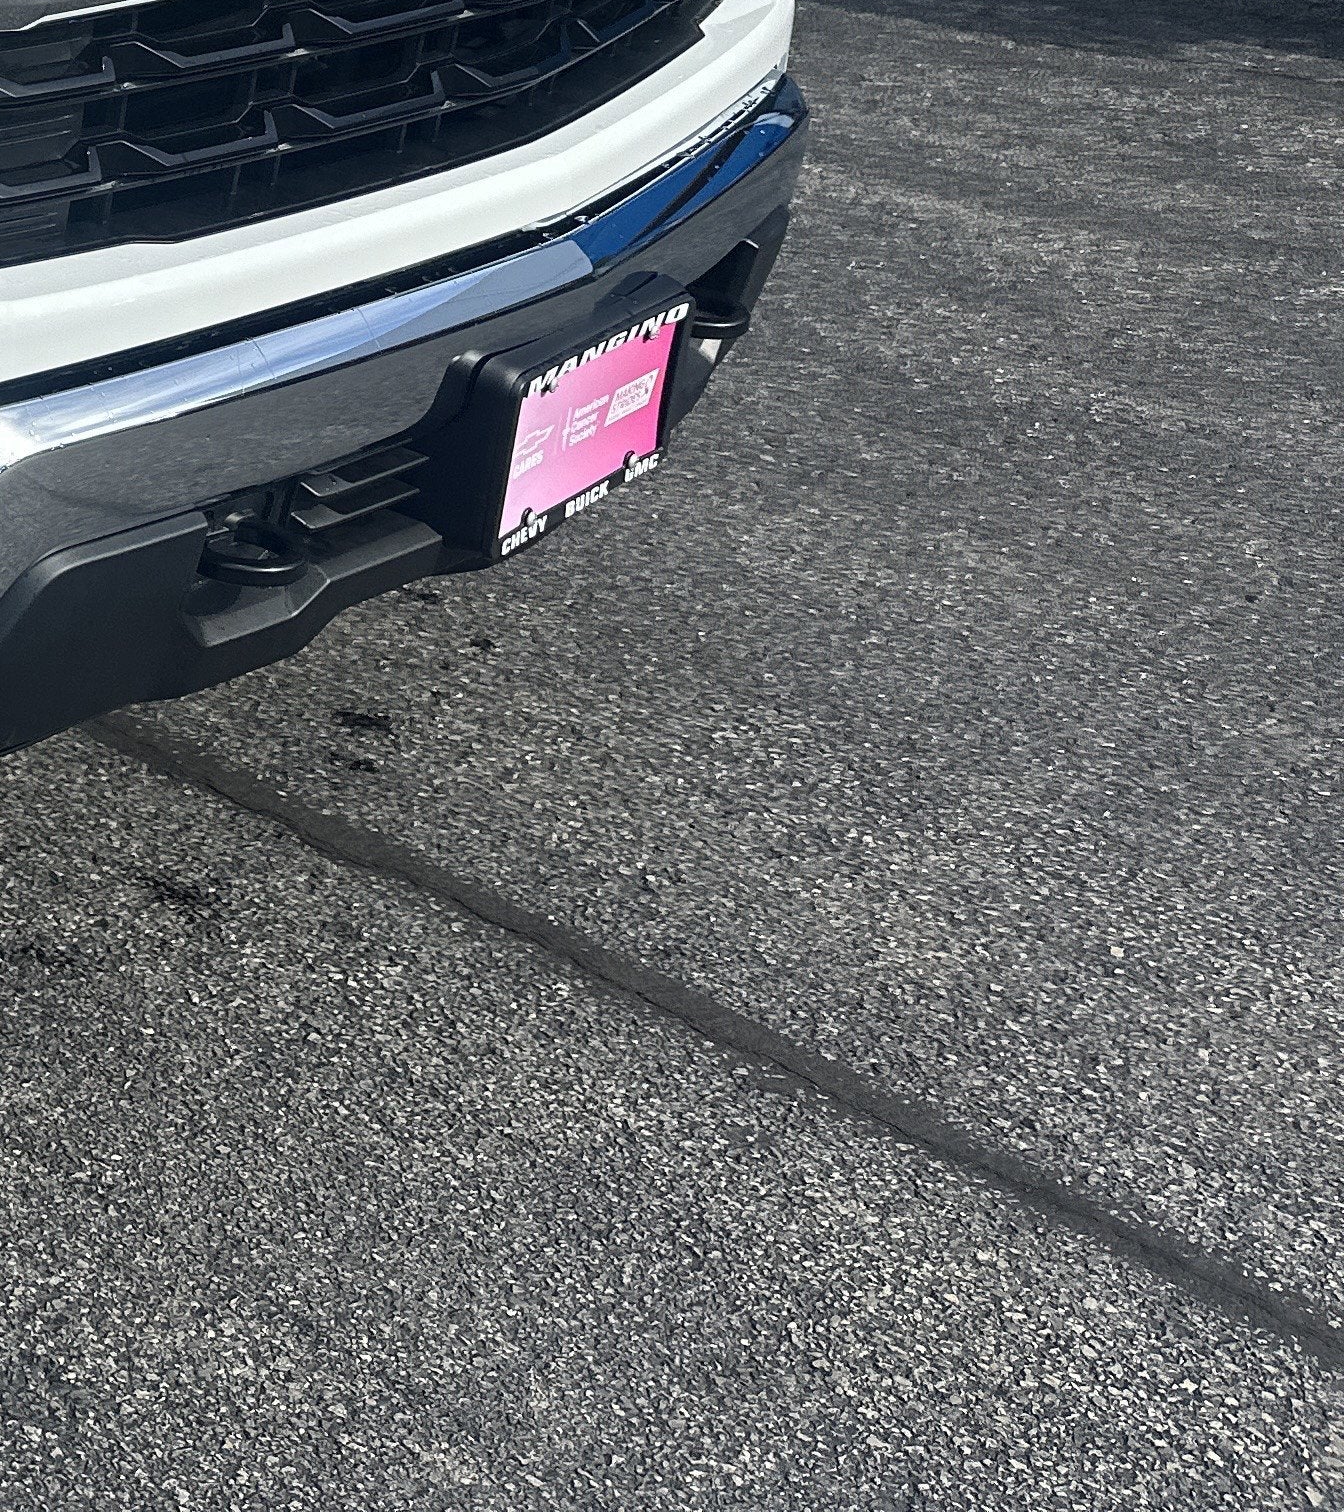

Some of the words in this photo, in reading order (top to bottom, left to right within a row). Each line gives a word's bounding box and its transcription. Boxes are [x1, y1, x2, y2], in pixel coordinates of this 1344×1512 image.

[528, 302, 690, 398] MANGINO
[501, 515, 548, 556] CHEVY
[564, 479, 610, 519] BUICK
[624, 453, 660, 483] GMC
